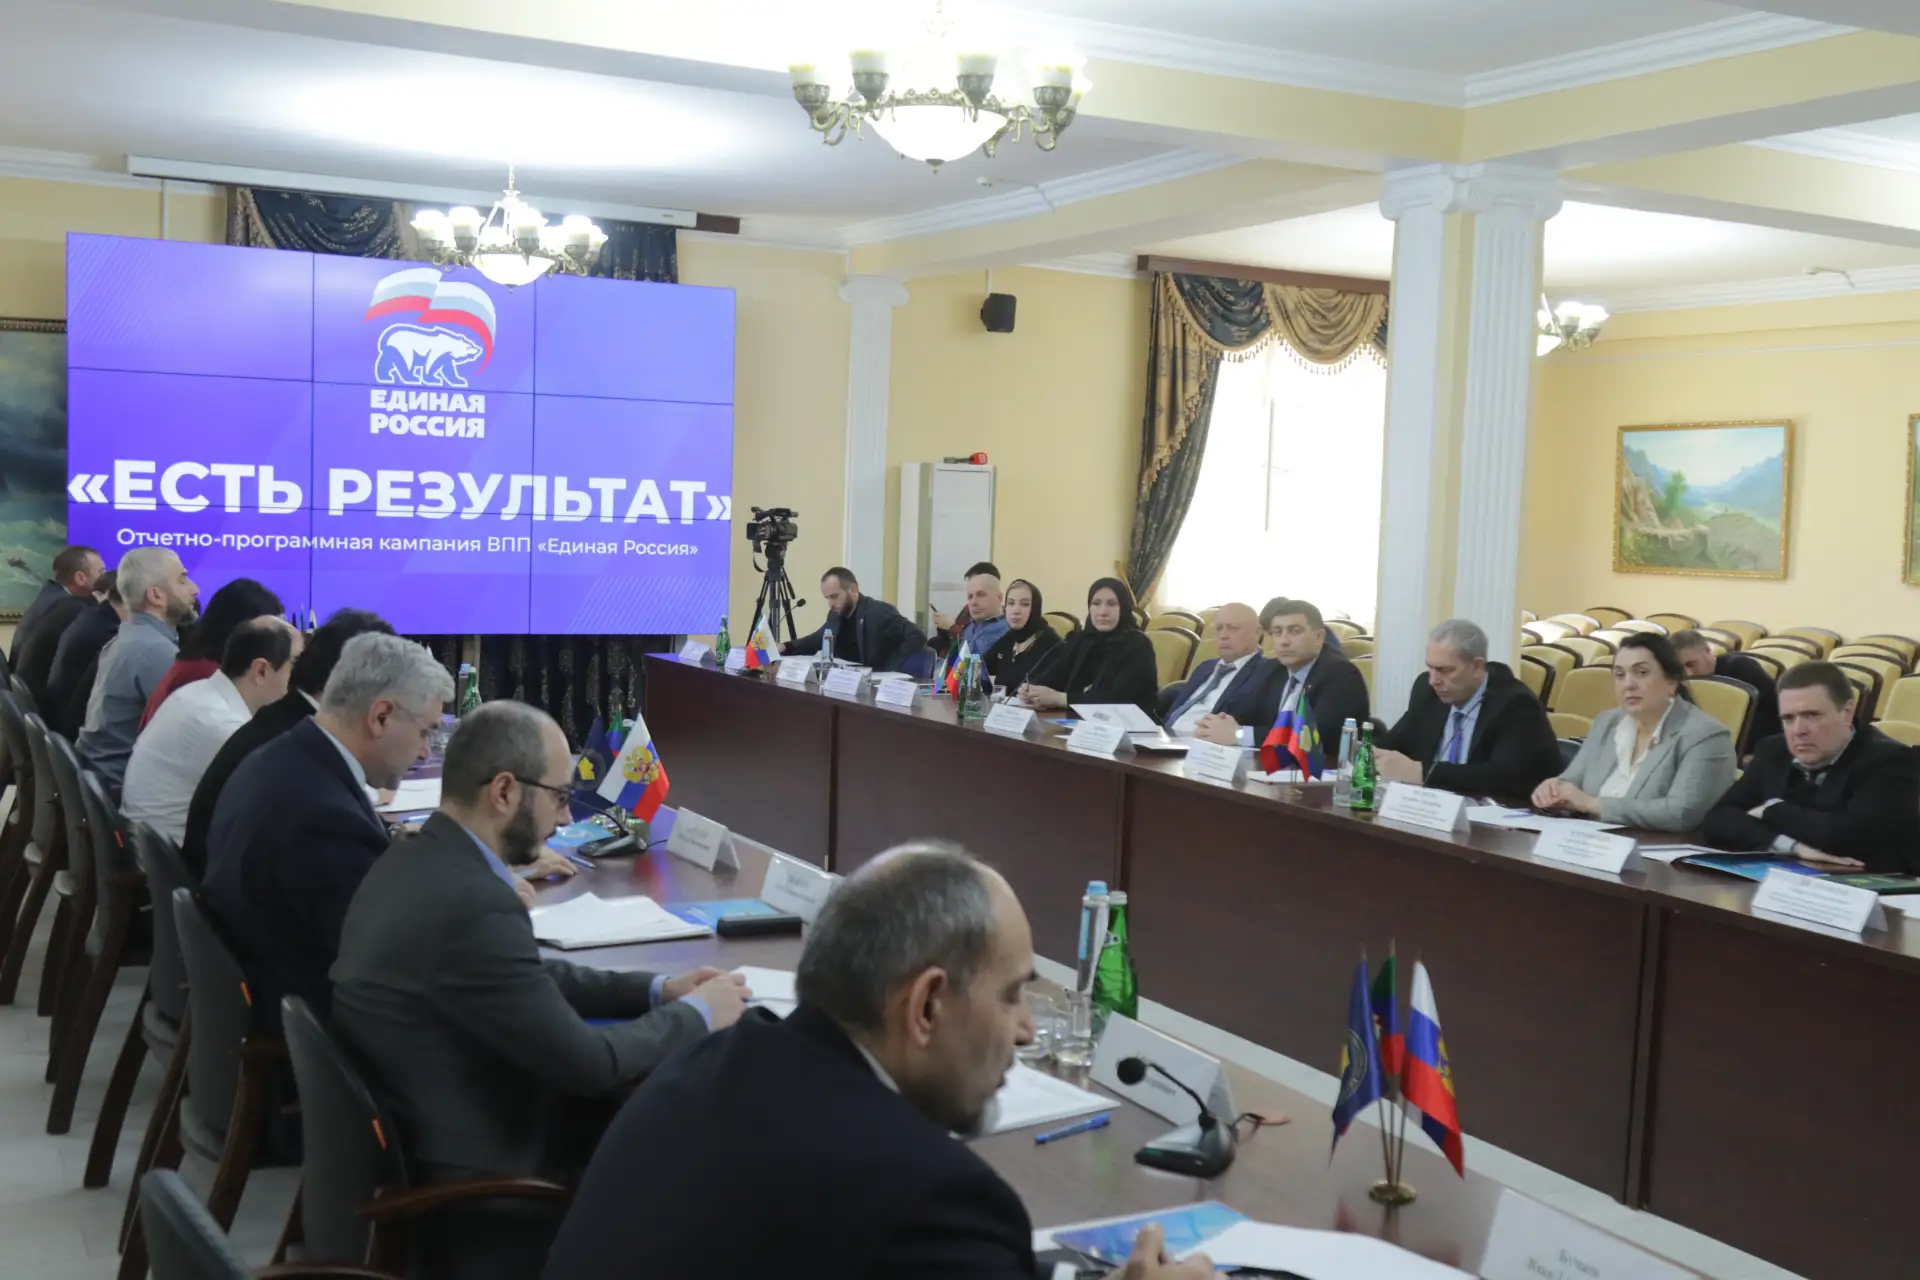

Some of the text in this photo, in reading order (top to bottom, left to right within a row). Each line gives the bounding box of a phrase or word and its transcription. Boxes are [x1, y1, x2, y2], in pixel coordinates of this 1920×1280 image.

[370, 389, 485, 413] ЕДИНАЯ
[370, 413, 485, 438] РОССИЯ
[67, 459, 731, 525] «ЕСТЬ РЕЗУЛЬТАТ»
[116, 528, 698, 556] Отчетно-программная кампания ВПП «Единая Россия»
